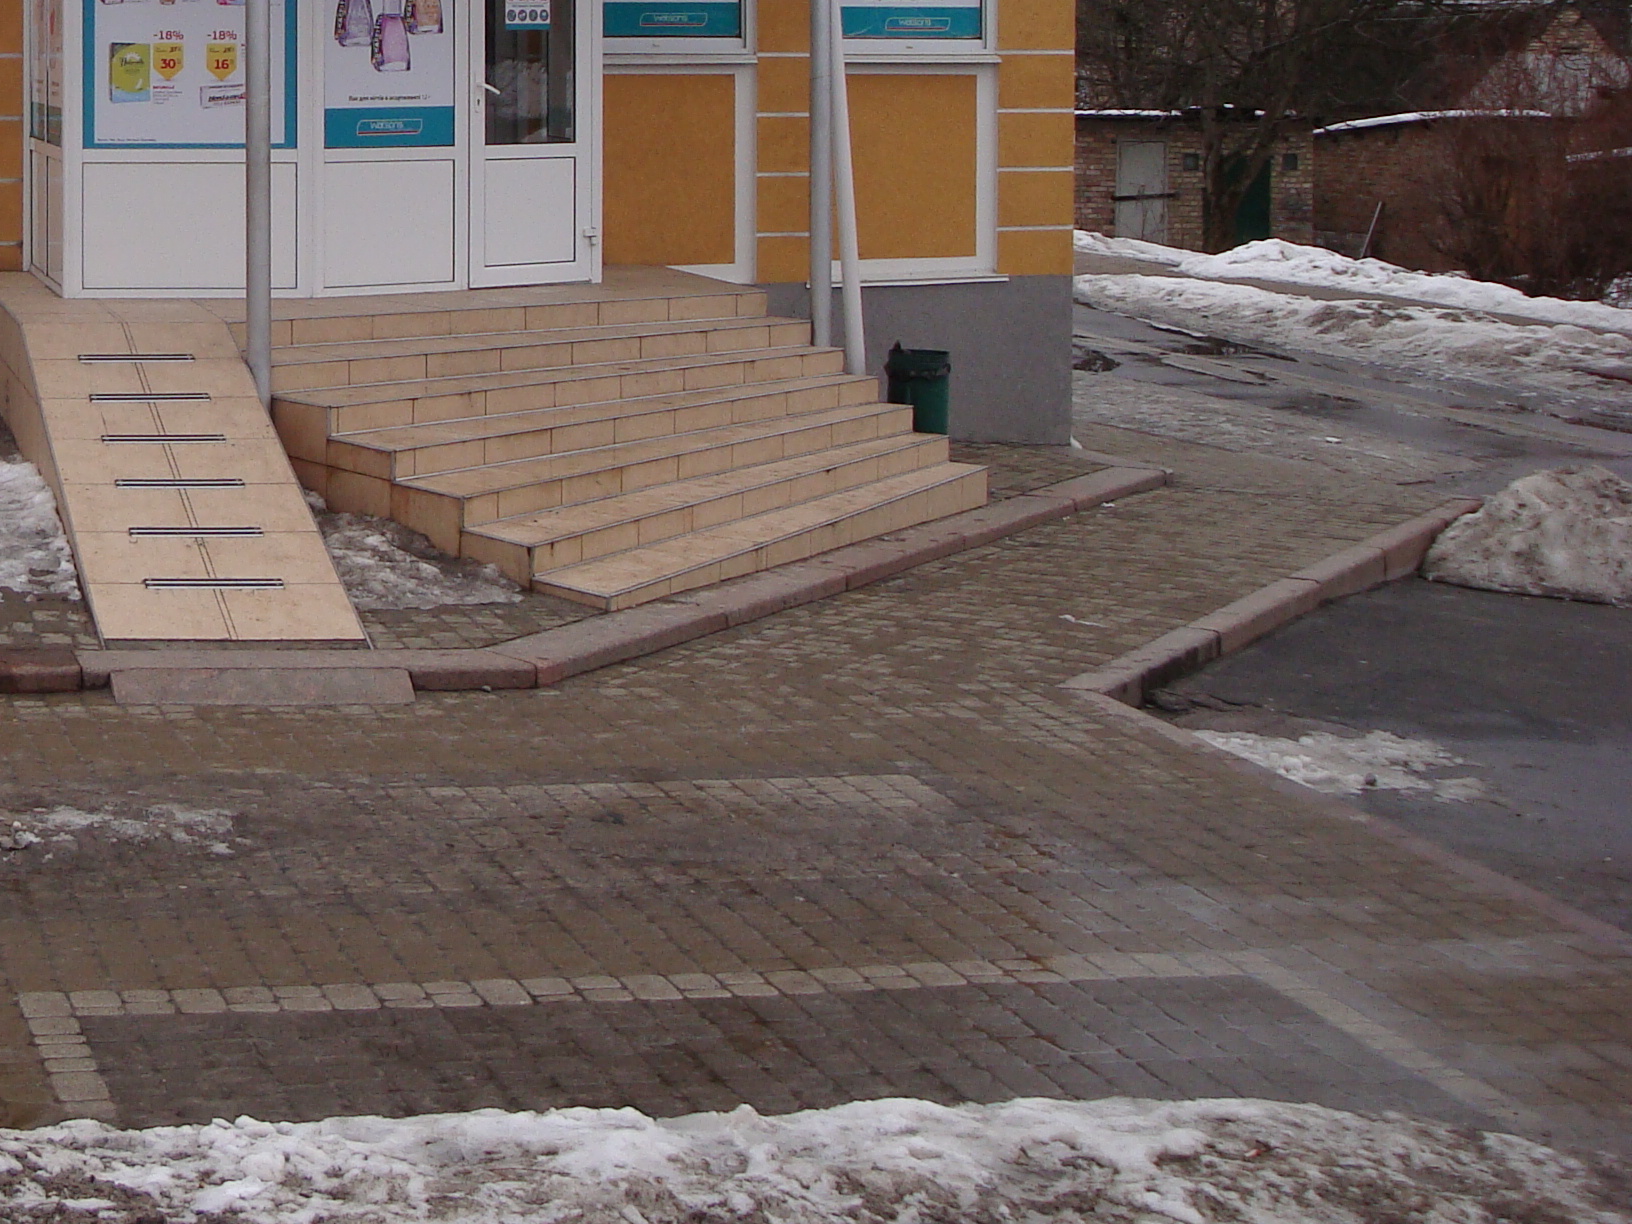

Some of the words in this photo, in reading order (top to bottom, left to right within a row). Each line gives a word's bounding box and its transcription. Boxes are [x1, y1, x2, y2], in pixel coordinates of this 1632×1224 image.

[153, 30, 184, 40] -18%
[206, 30, 237, 40] -18%
[160, 59, 176, 69] 30
[214, 59, 229, 69] 16
